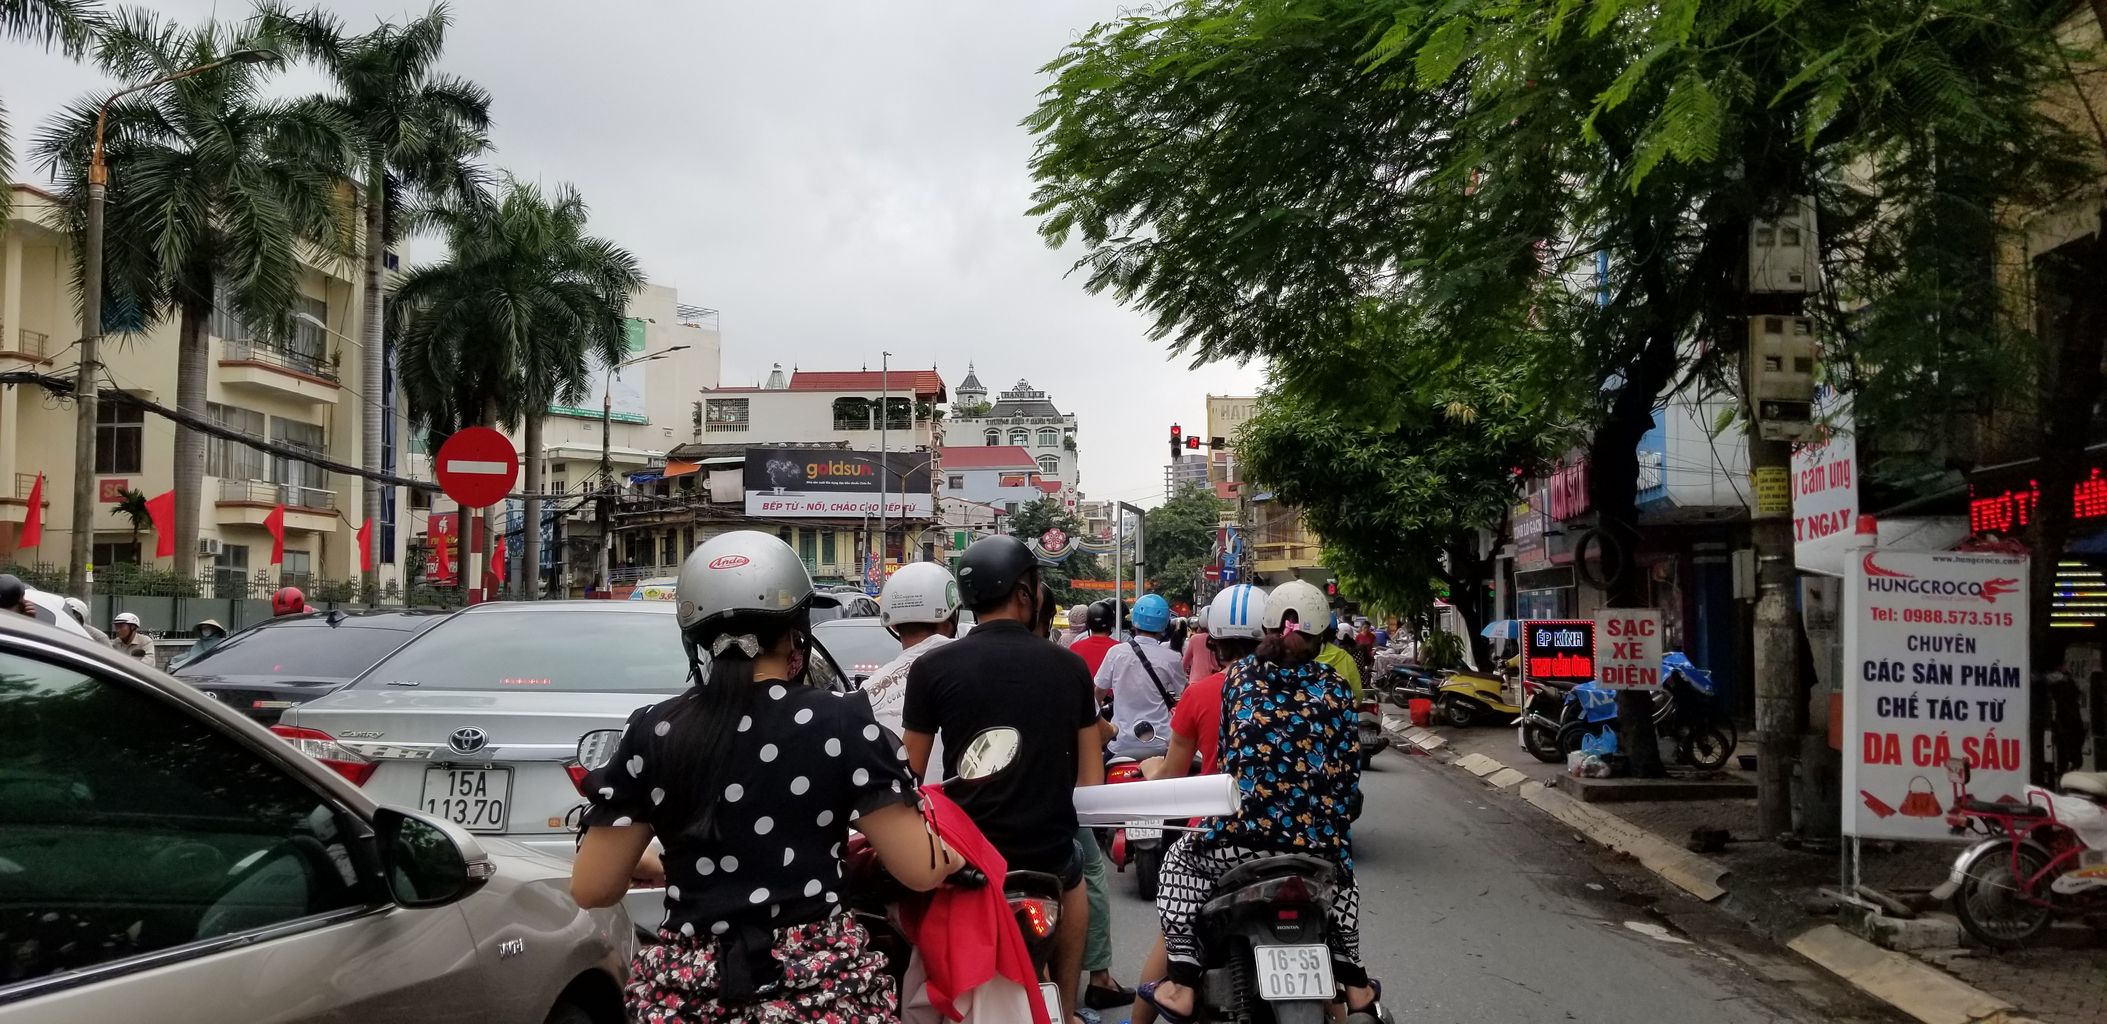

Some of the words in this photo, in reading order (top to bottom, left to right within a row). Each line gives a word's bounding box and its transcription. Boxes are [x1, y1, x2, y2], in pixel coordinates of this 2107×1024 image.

[806, 460, 872, 479] goldsun
[762, 500, 783, 511] BẾP
[1808, 508, 1851, 540] NGAY
[1932, 555, 2020, 566] www.hungcroco.com
[1867, 577, 1982, 596] HUNGCROCO
[1871, 607, 1898, 622] Tel:
[1903, 608, 2013, 627] 0988.573.515
[1536, 629, 1551, 647] ÉP
[1554, 628, 1583, 647] KÍNH
[1607, 618, 1655, 641] SẠC
[1612, 642, 1643, 660] XE
[1907, 633, 1976, 654] CHUYÊN
[1863, 658, 1905, 683] CÁC
[1912, 658, 1953, 685] SẢN
[1961, 659, 2020, 688] PHẨM
[1877, 691, 1919, 719] CHẾ
[1926, 696, 1969, 721] TÁC
[1976, 698, 2006, 723] TỪ
[1863, 732, 1902, 766] DA
[1912, 730, 1952, 768] CÁ
[1961, 727, 2020, 771] SẤU
[448, 771, 487, 798] 15A
[427, 799, 503, 826] 113.70
[1267, 949, 1320, 971] 16-S5
[1270, 973, 1323, 995] 0671
